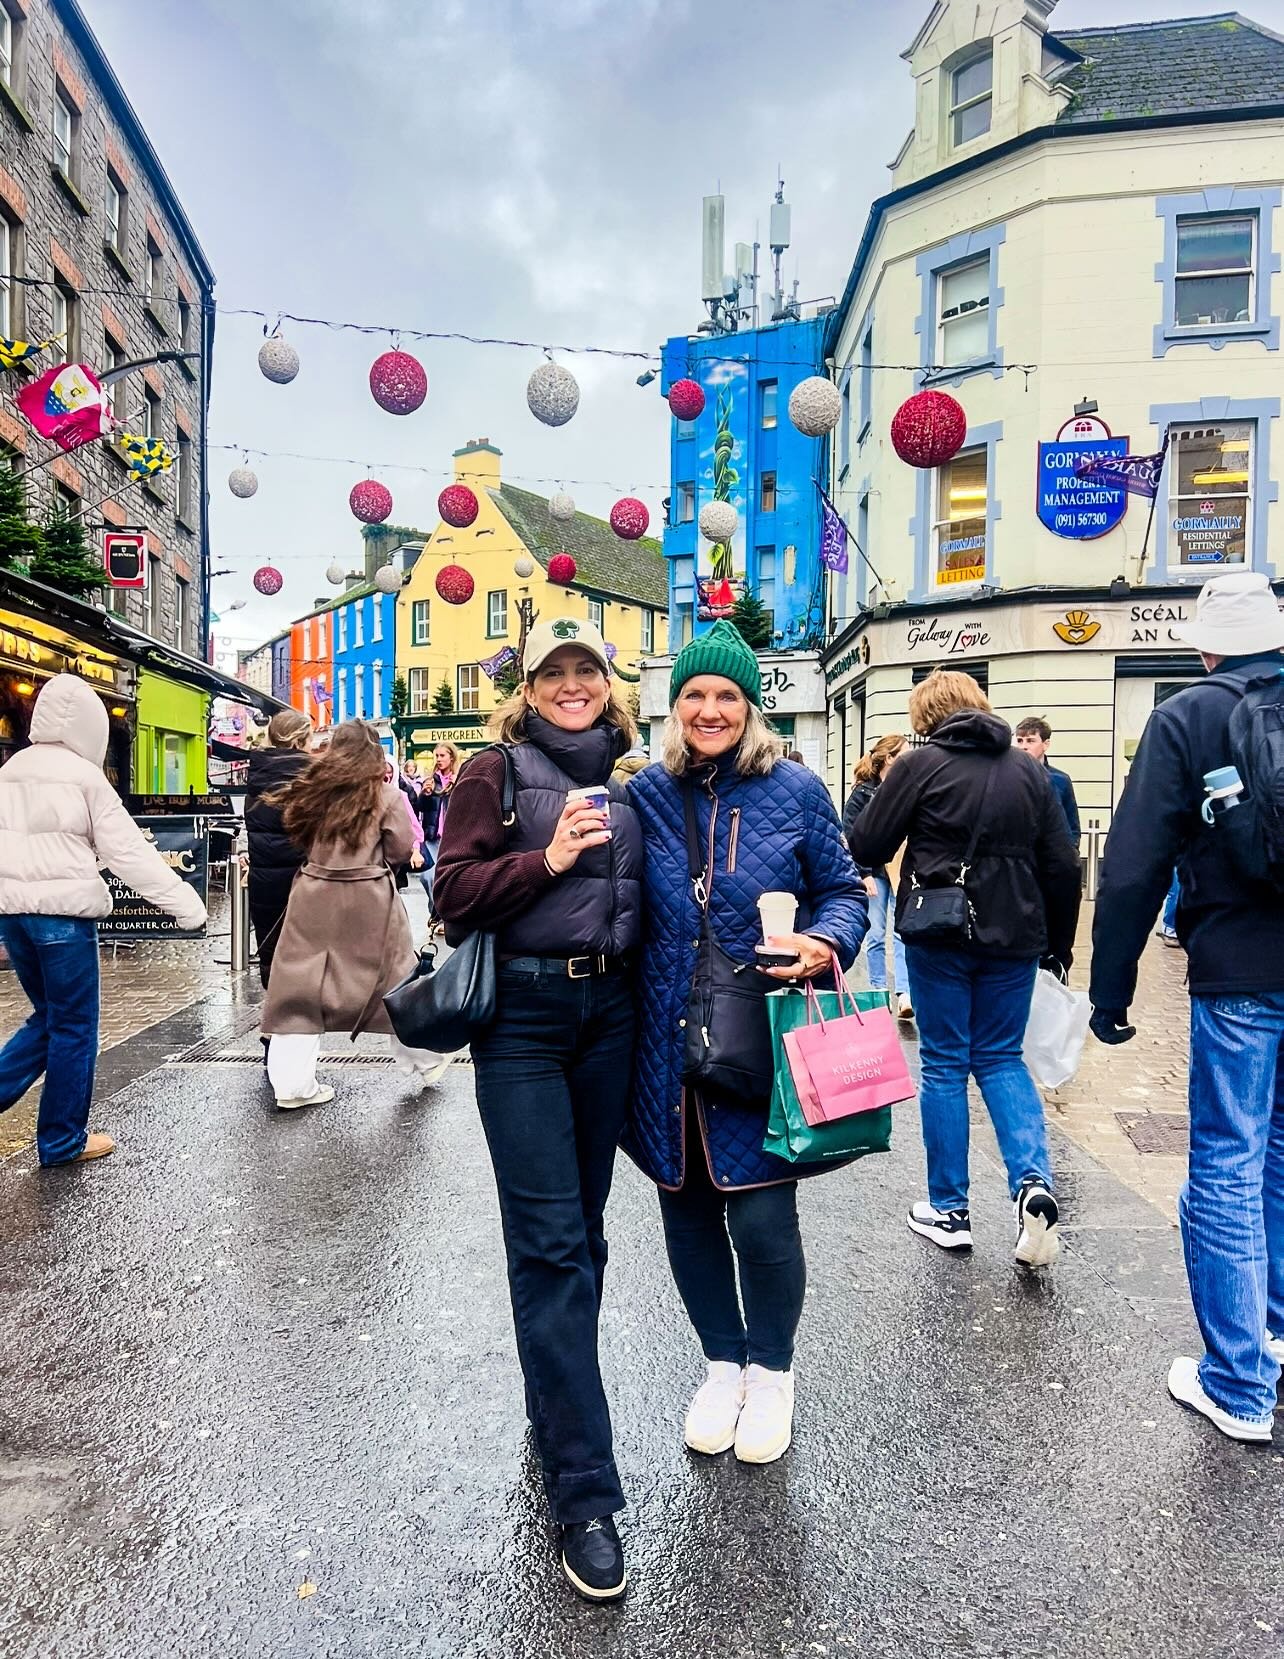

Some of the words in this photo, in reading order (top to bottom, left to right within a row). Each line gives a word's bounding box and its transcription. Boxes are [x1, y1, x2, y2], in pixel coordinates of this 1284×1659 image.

[1044, 491, 1120, 506] MANAGEMENT
[1055, 513, 1075, 529] (091)
[1077, 512, 1107, 526] 567300
[1172, 515, 1242, 531] GORMALLY
[1182, 531, 1232, 541] RESIDENTIAL
[1188, 541, 1225, 550] LETTINGS
[964, 622, 982, 630] WITH
[907, 618, 953, 651] Galway
[1131, 628, 1158, 642] AN
[431, 729, 484, 741] EVERGREEN
[107, 877, 127, 889] 30p
[115, 889, 142, 899] DAIL
[97, 921, 113, 930] TIN
[115, 922, 160, 931] QUARTER
[161, 921, 179, 930] GAL
[831, 1055, 884, 1076] KILKENNY
[842, 1067, 882, 1085] DESIGN
